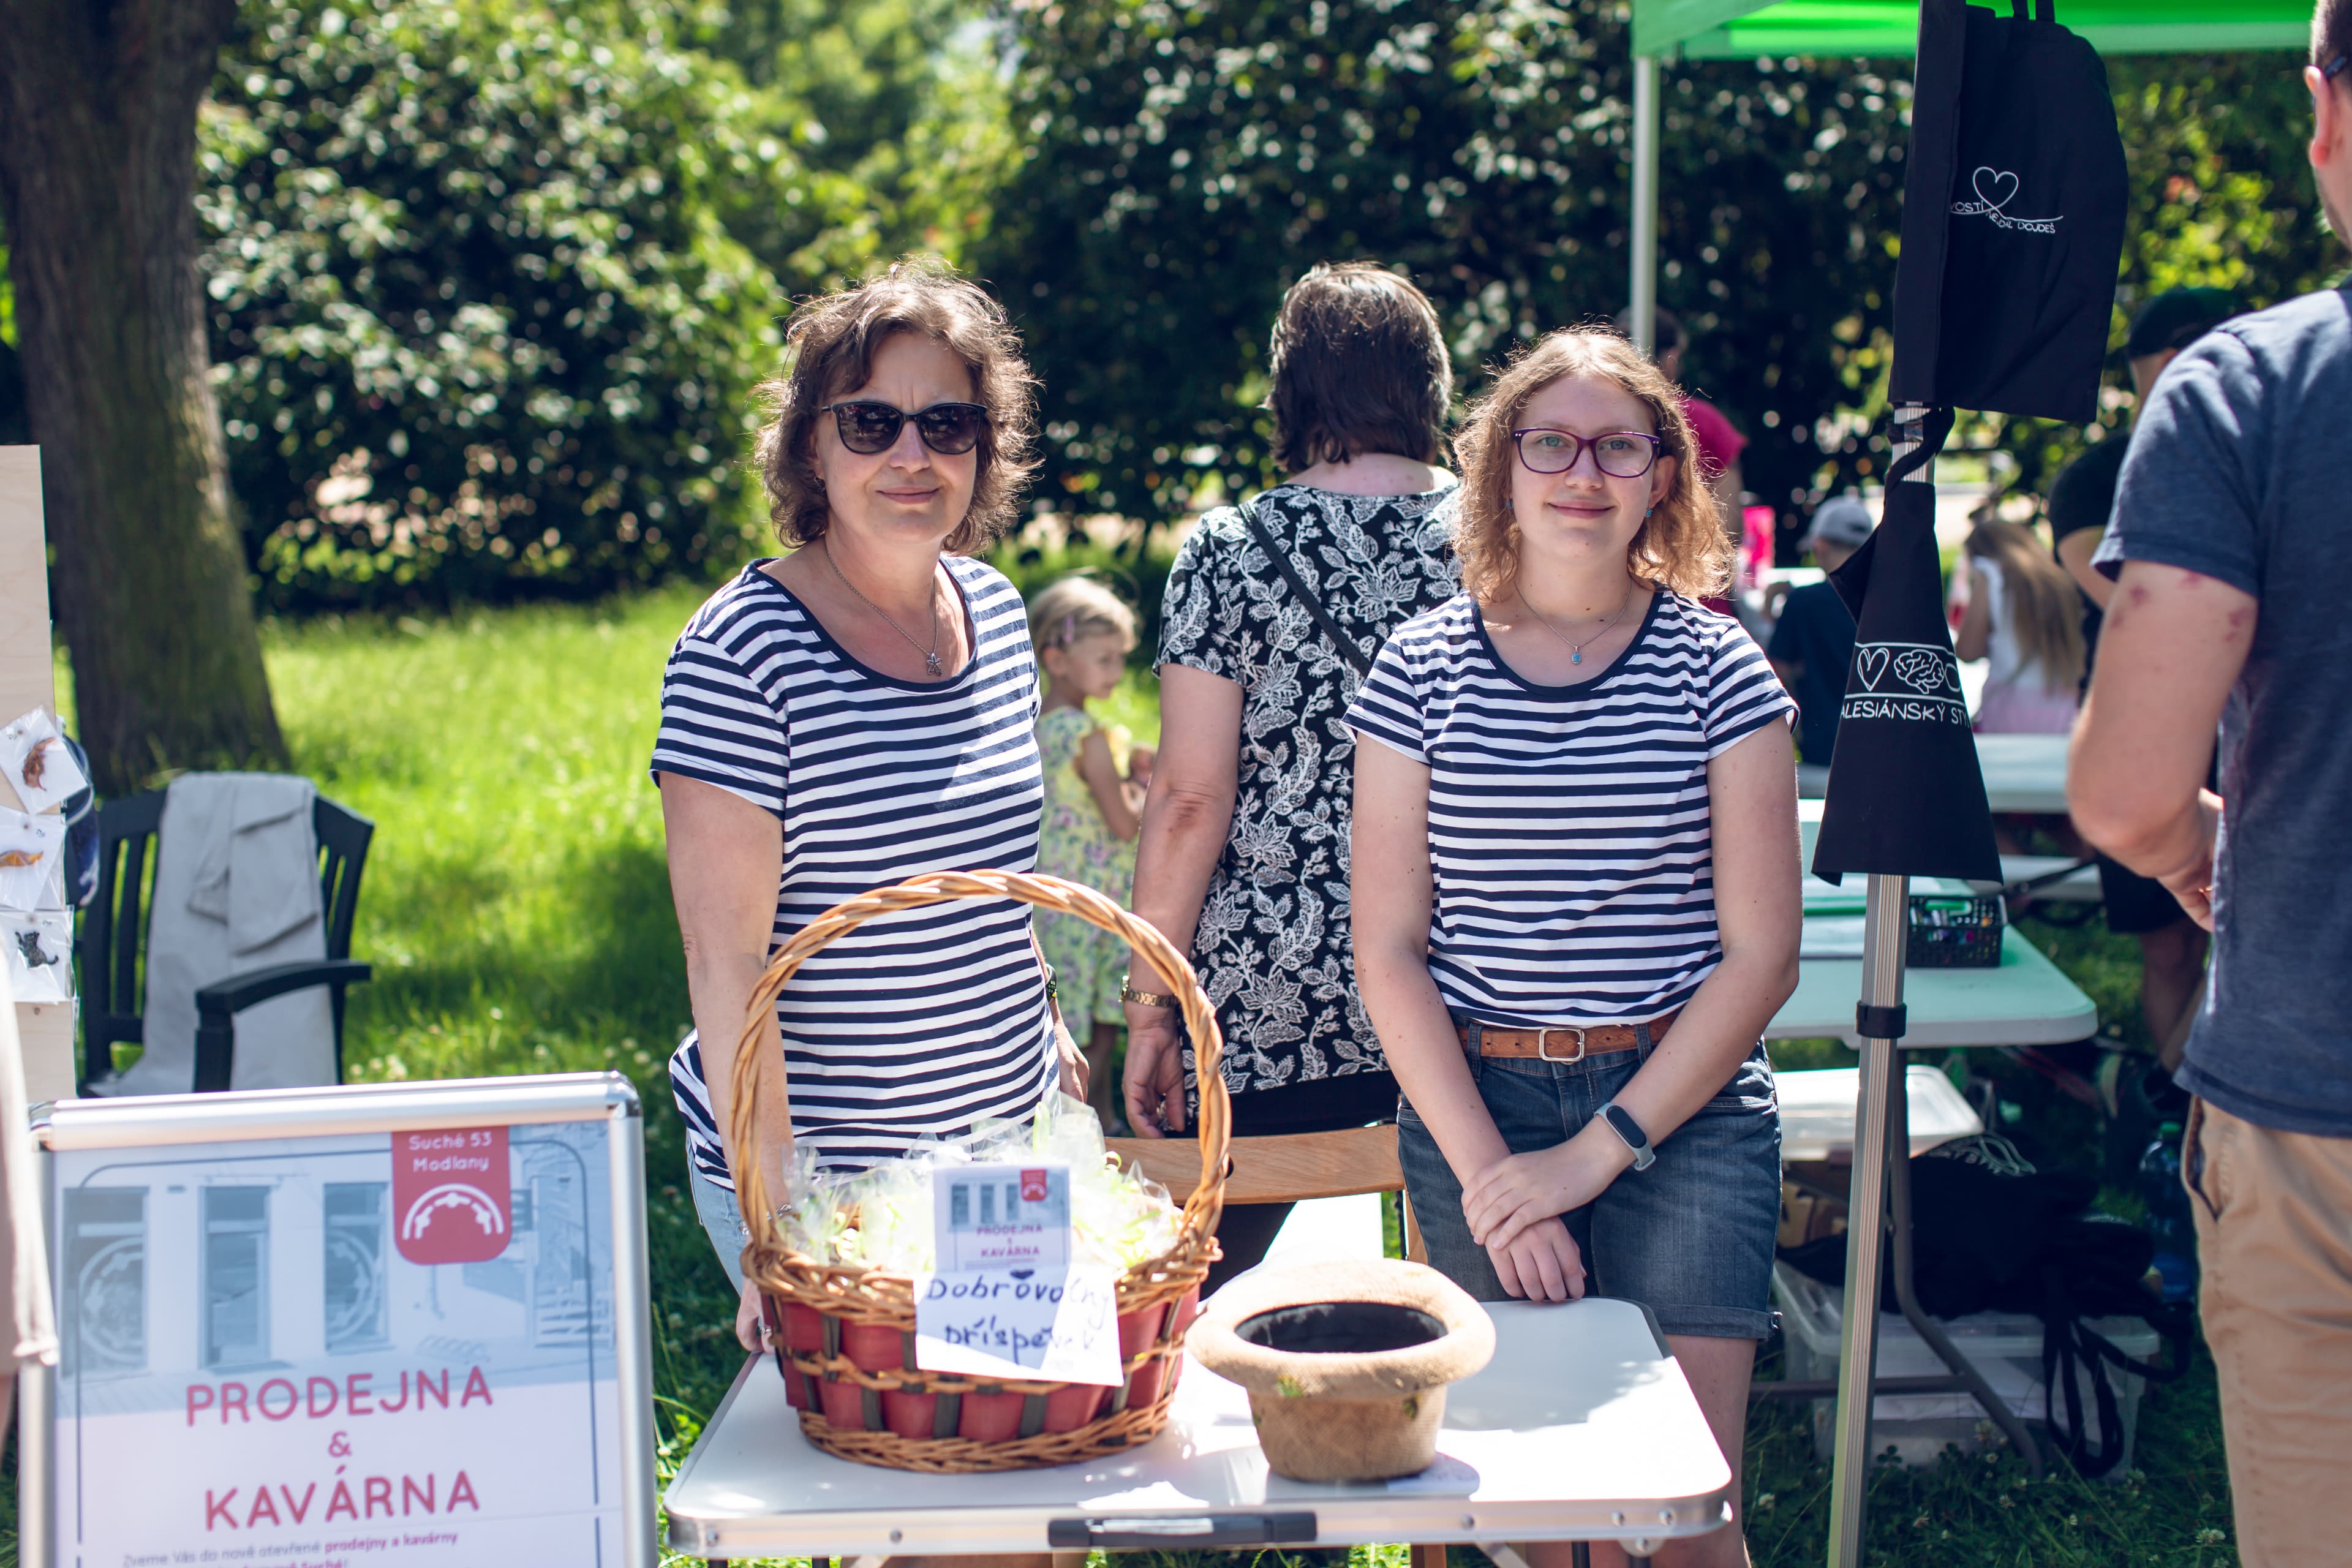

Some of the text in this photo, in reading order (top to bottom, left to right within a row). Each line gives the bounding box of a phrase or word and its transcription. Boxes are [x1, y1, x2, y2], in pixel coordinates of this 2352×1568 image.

[409, 1131, 492, 1150] Suché 53
[413, 1157, 489, 1172] Modlany
[187, 1366, 493, 1427] PRODEJNA
[328, 1431, 352, 1458] &
[205, 1464, 480, 1531] KAVÁRNA
[172, 1550, 195, 1563] Vás
[200, 1548, 216, 1562] do
[325, 1537, 387, 1555] prodejny
[390, 1536, 399, 1547] a
[402, 1532, 458, 1546] kavárny
